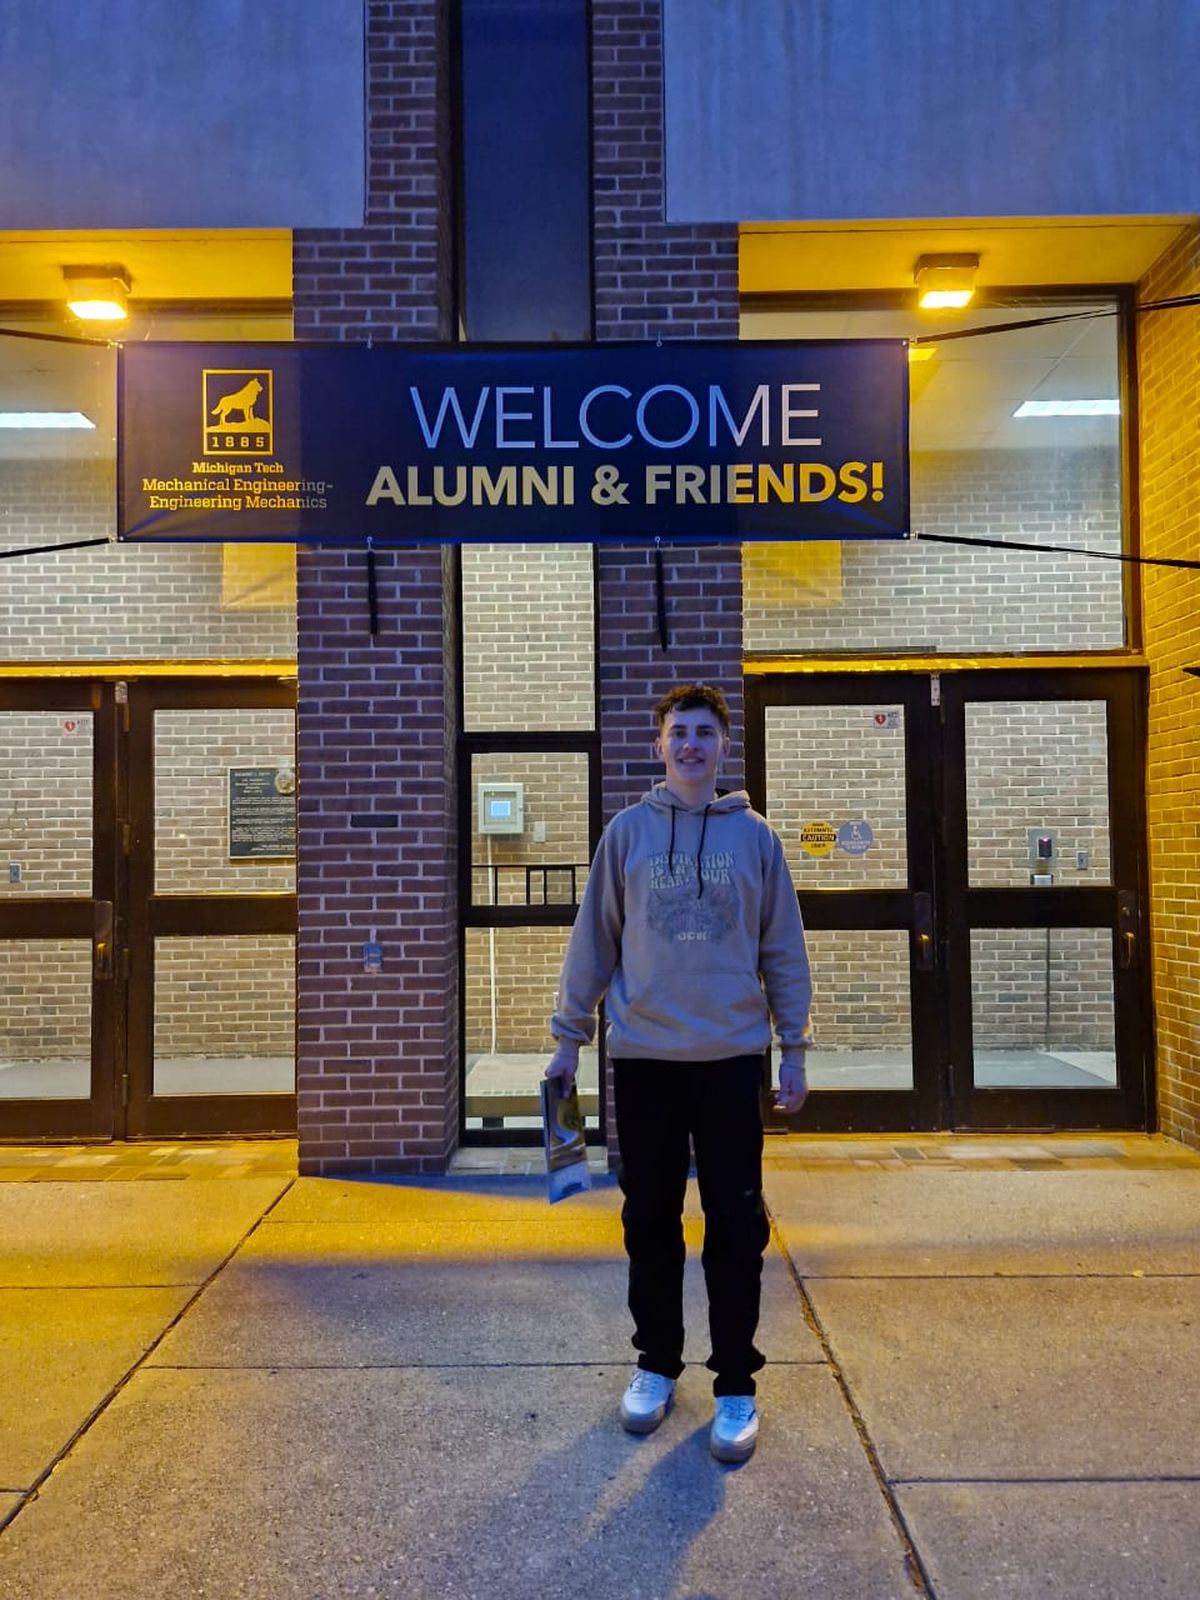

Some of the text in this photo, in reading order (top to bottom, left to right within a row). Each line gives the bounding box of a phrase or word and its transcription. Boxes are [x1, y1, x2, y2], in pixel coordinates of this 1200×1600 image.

[410, 383, 822, 450] WELCOME
[211, 436, 265, 448] 1885
[192, 462, 284, 474] Michigan Tech
[142, 478, 333, 495] Mechanical Engineering-
[366, 461, 884, 507] ALUMNI & FRIENDS!
[149, 495, 327, 511] Engineering Mechanics
